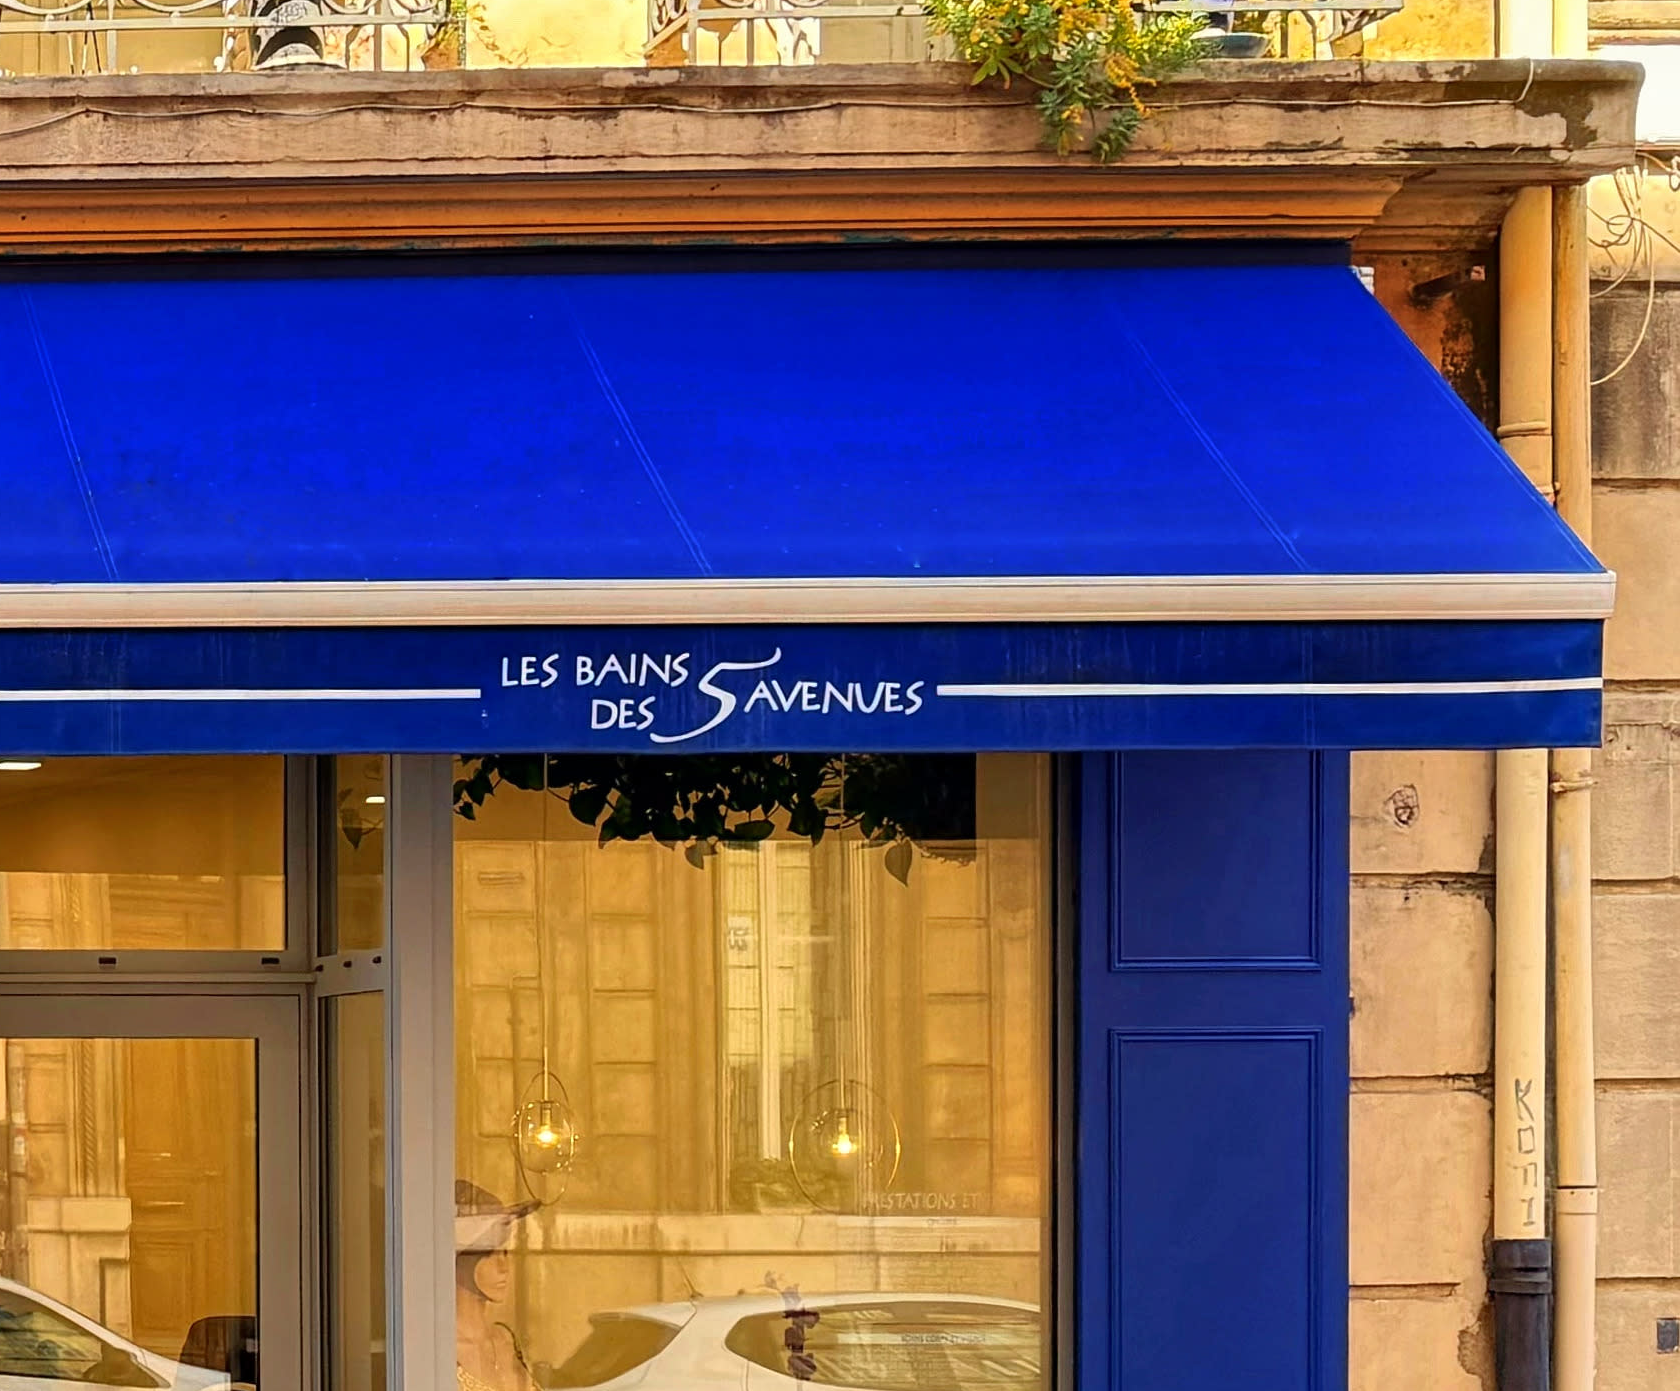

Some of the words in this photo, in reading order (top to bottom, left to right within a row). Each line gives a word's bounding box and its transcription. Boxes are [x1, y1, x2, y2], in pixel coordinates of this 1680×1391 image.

[501, 654, 560, 688] LES
[577, 653, 690, 687] BAINS
[592, 696, 656, 730] DES
[649, 648, 782, 743] 5
[743, 680, 925, 714] AVENUES
